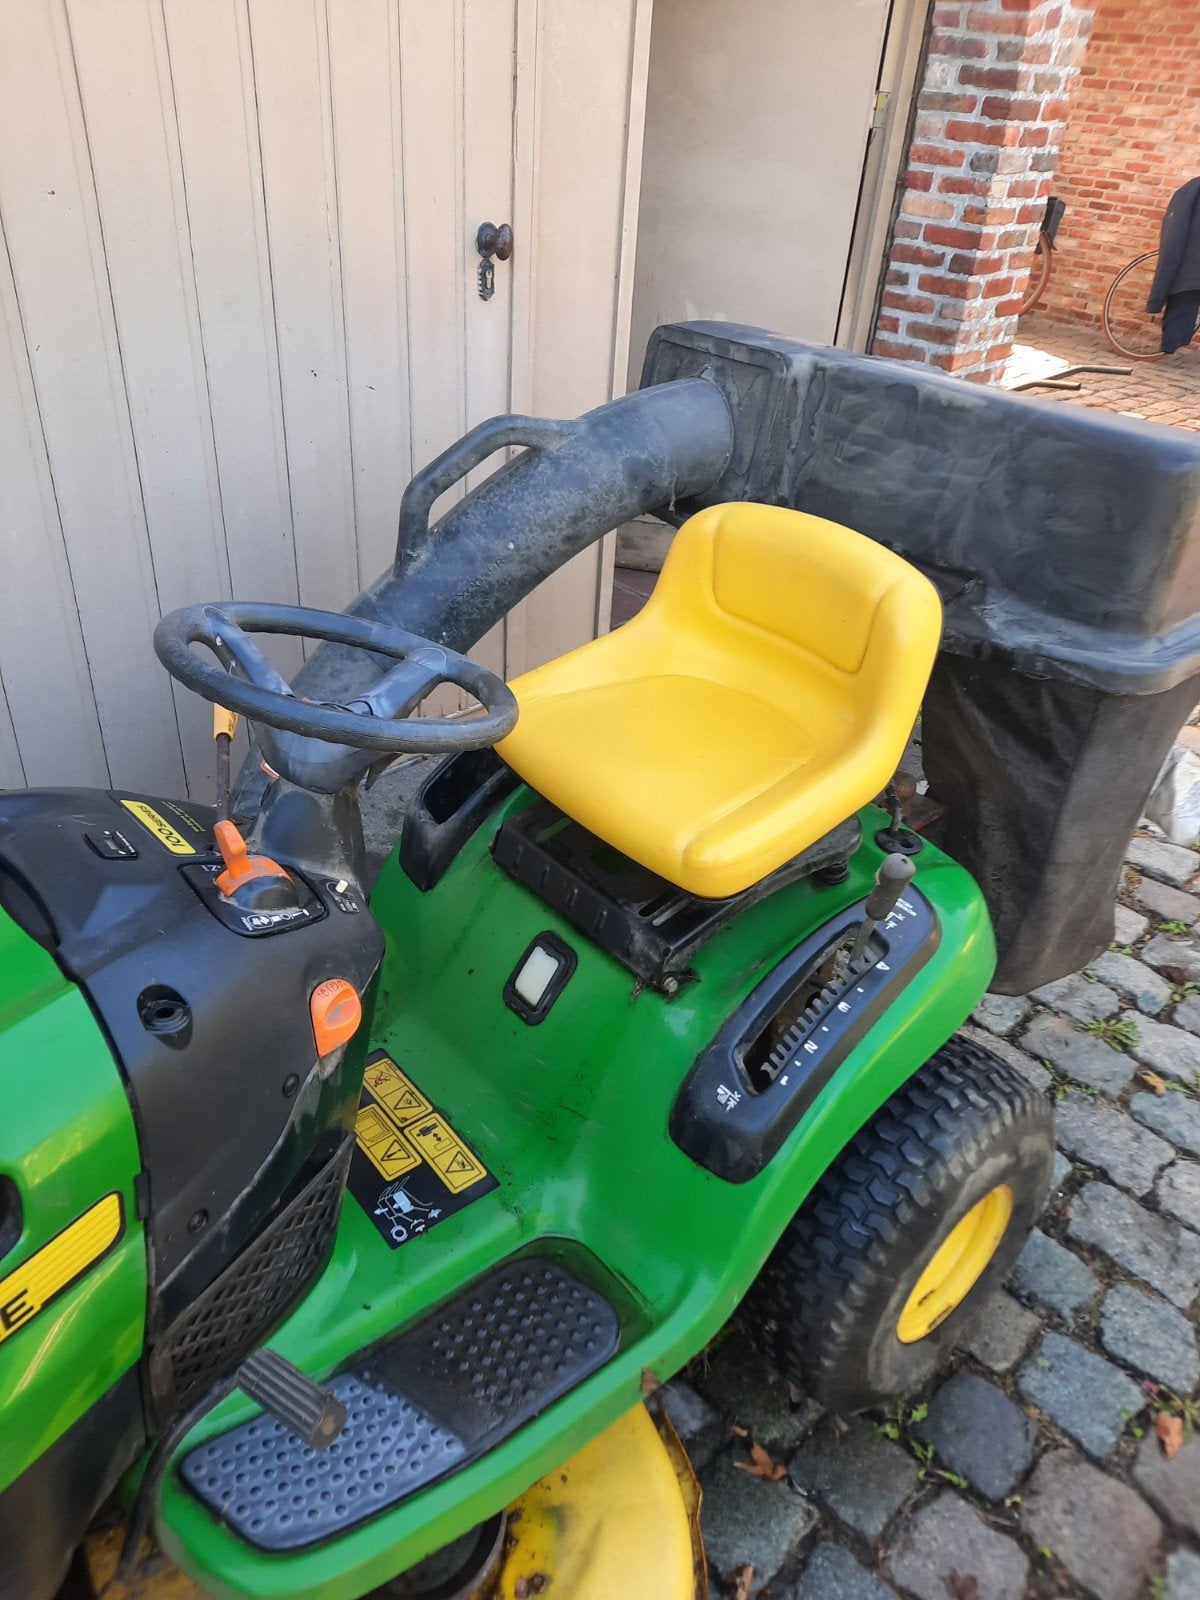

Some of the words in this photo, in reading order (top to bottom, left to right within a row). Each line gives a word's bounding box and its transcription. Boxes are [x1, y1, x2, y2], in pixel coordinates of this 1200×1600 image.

[136, 803, 167, 828] SERIES
[158, 828, 186, 847] 100
[876, 961, 890, 970] 4
[838, 1002, 851, 1013] 3
[804, 1040, 818, 1054] 2
[780, 1075, 789, 1086] 1
